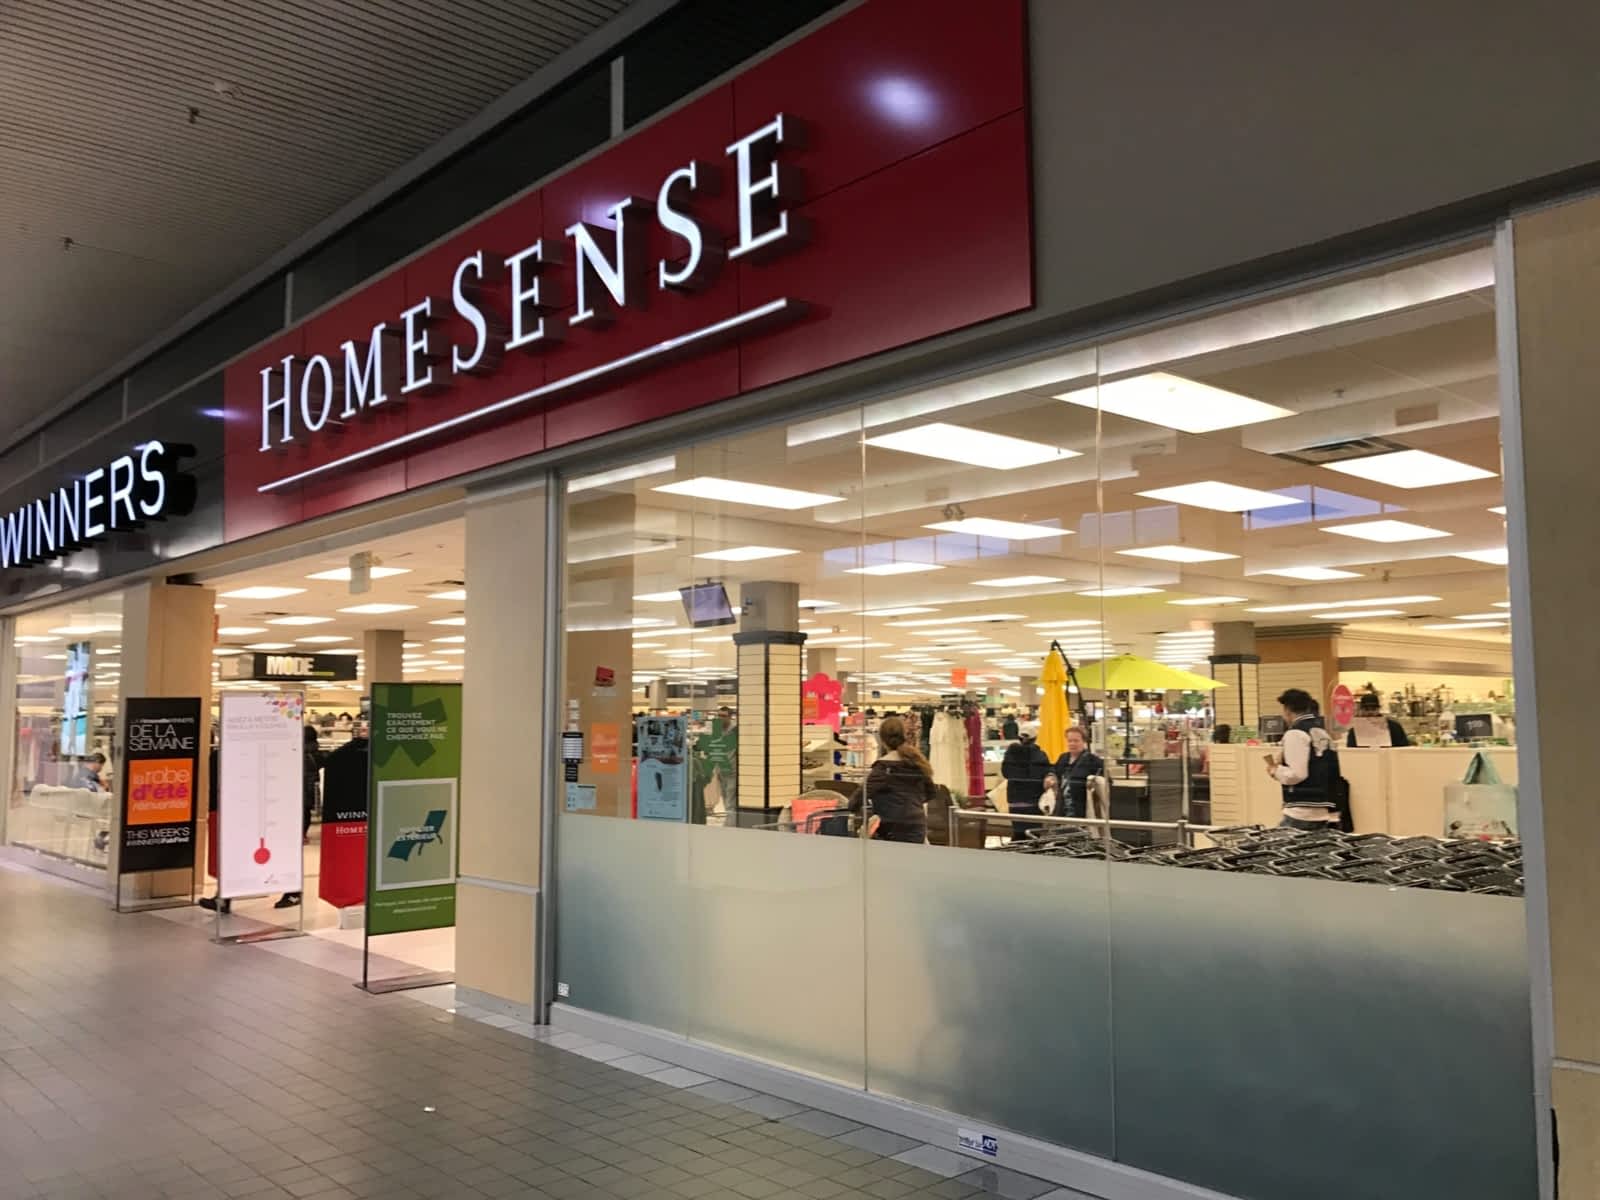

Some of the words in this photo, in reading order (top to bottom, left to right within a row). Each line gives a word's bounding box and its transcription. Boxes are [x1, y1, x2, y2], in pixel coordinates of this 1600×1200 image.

[0, 440, 165, 569] WINNERS
[266, 655, 314, 675] MODE
[129, 724, 153, 738] DE
[154, 724, 177, 738] LA
[386, 726, 396, 734] CE
[398, 726, 414, 734] QUE
[128, 737, 194, 751] SEMAINE
[145, 766, 190, 784] robe
[132, 782, 189, 801] d'été
[126, 830, 149, 840] THIS
[149, 827, 190, 838] WEEK'S
